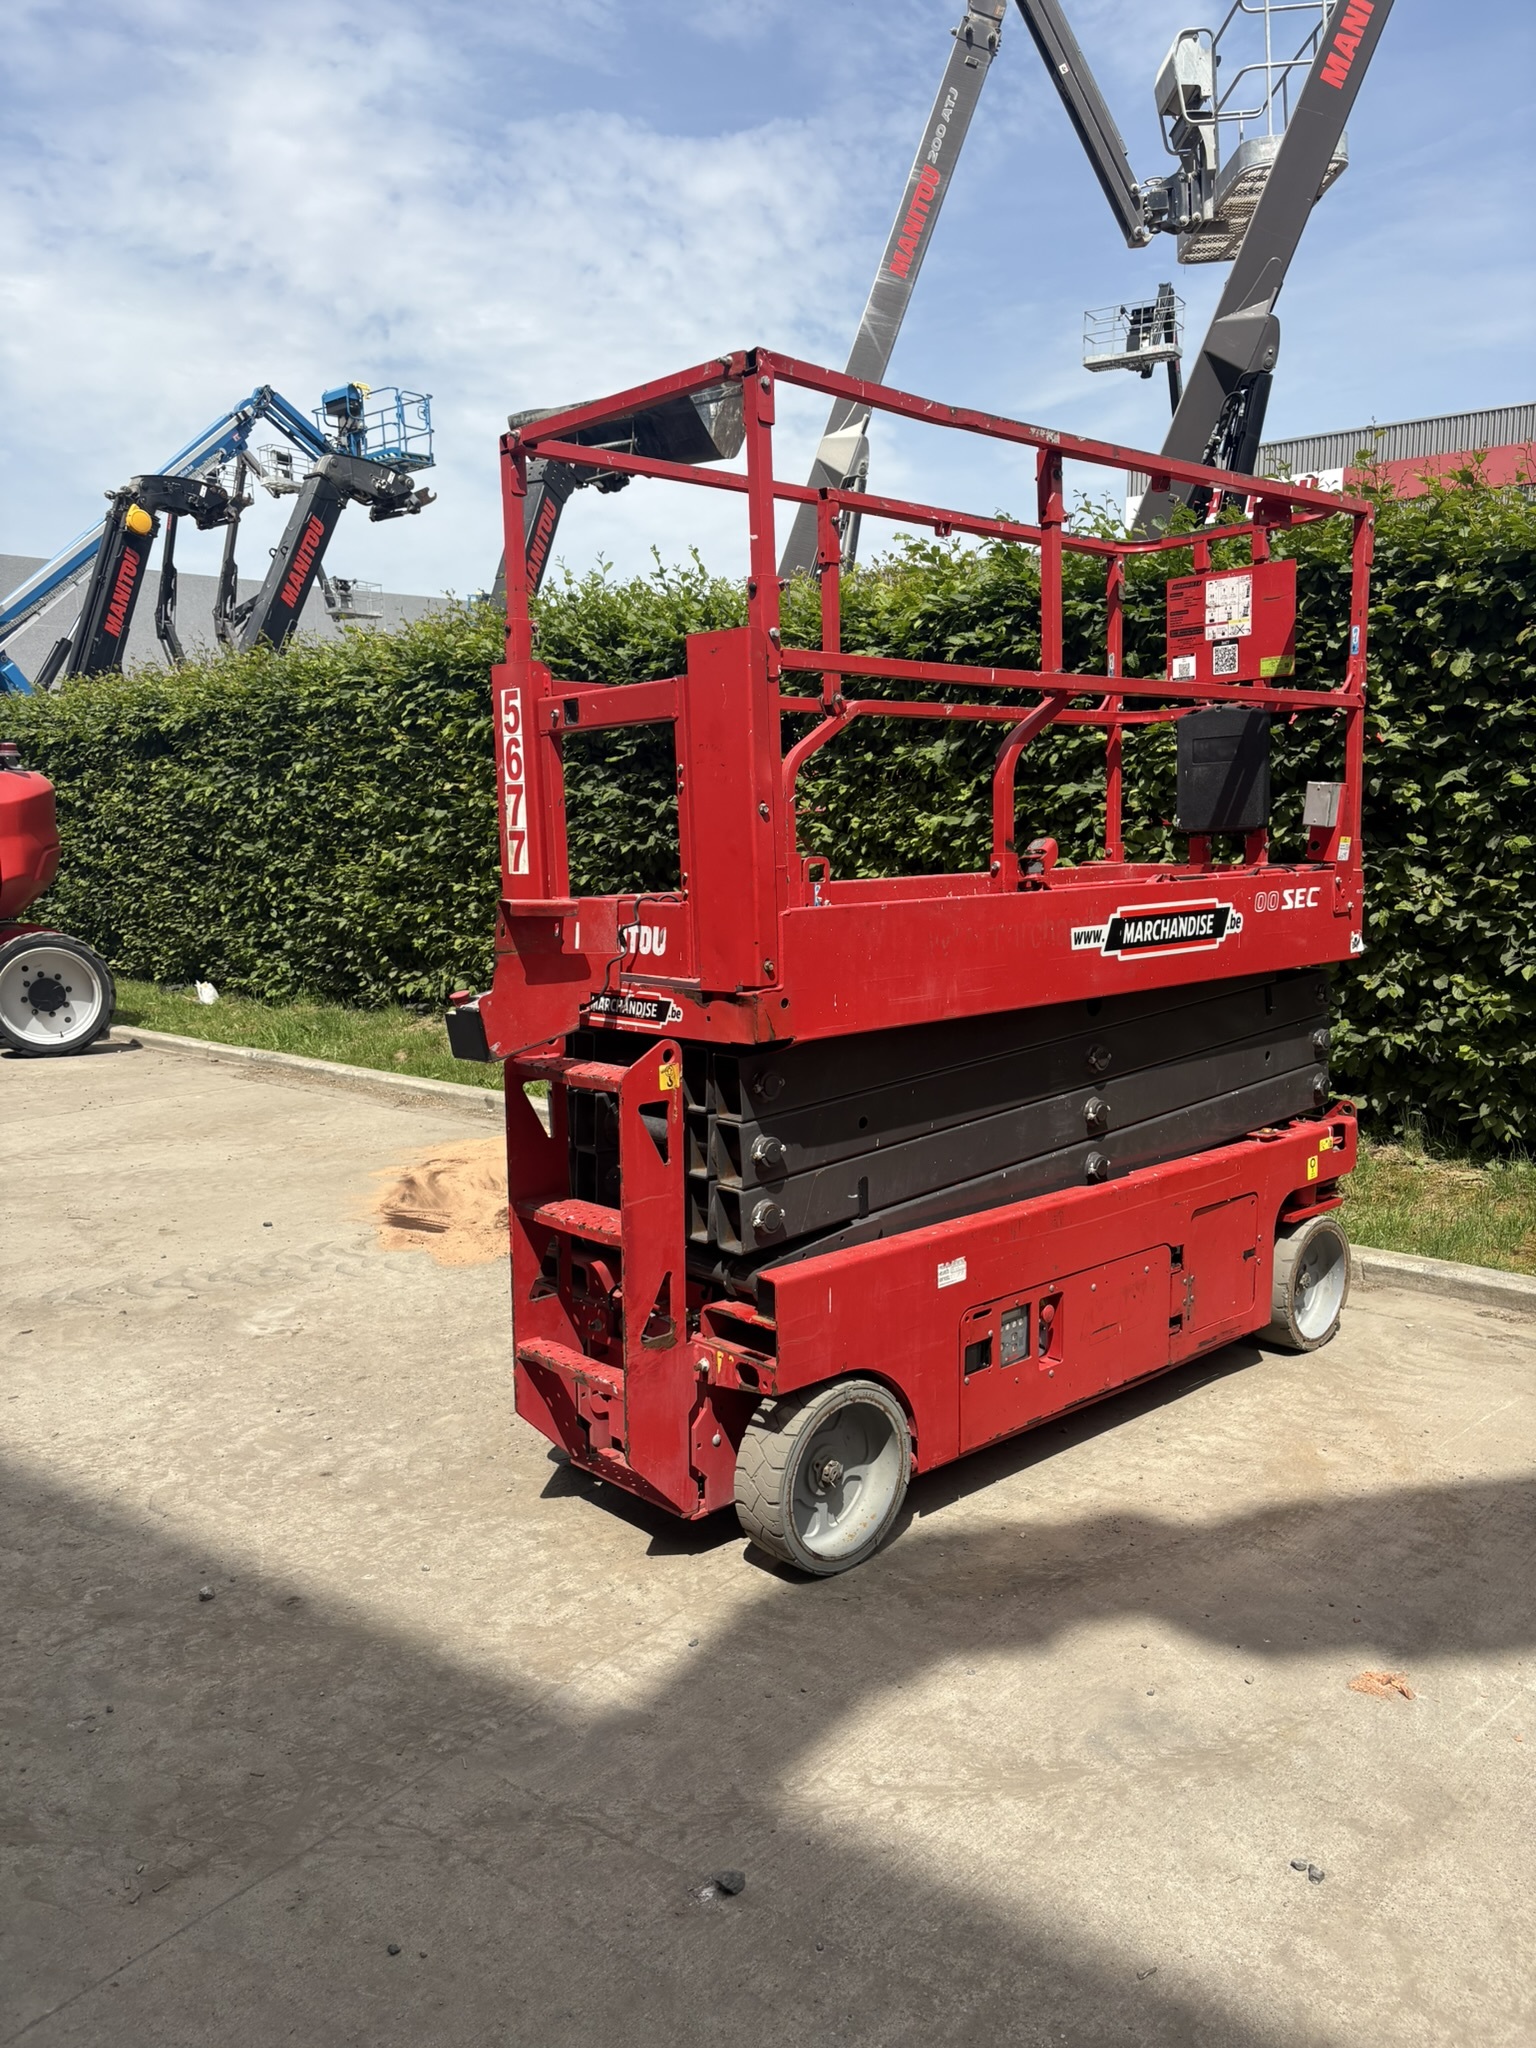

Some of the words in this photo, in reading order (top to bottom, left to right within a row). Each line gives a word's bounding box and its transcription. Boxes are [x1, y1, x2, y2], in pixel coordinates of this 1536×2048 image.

[890, 164, 940, 279] MANITOU
[927, 123, 947, 164] 200
[943, 86, 958, 123] ATJ
[104, 546, 141, 638] MANITOU
[280, 514, 325, 609] MANITOU
[503, 691, 526, 873] 5677
[1123, 914, 1215, 944] MARCHANDISE
